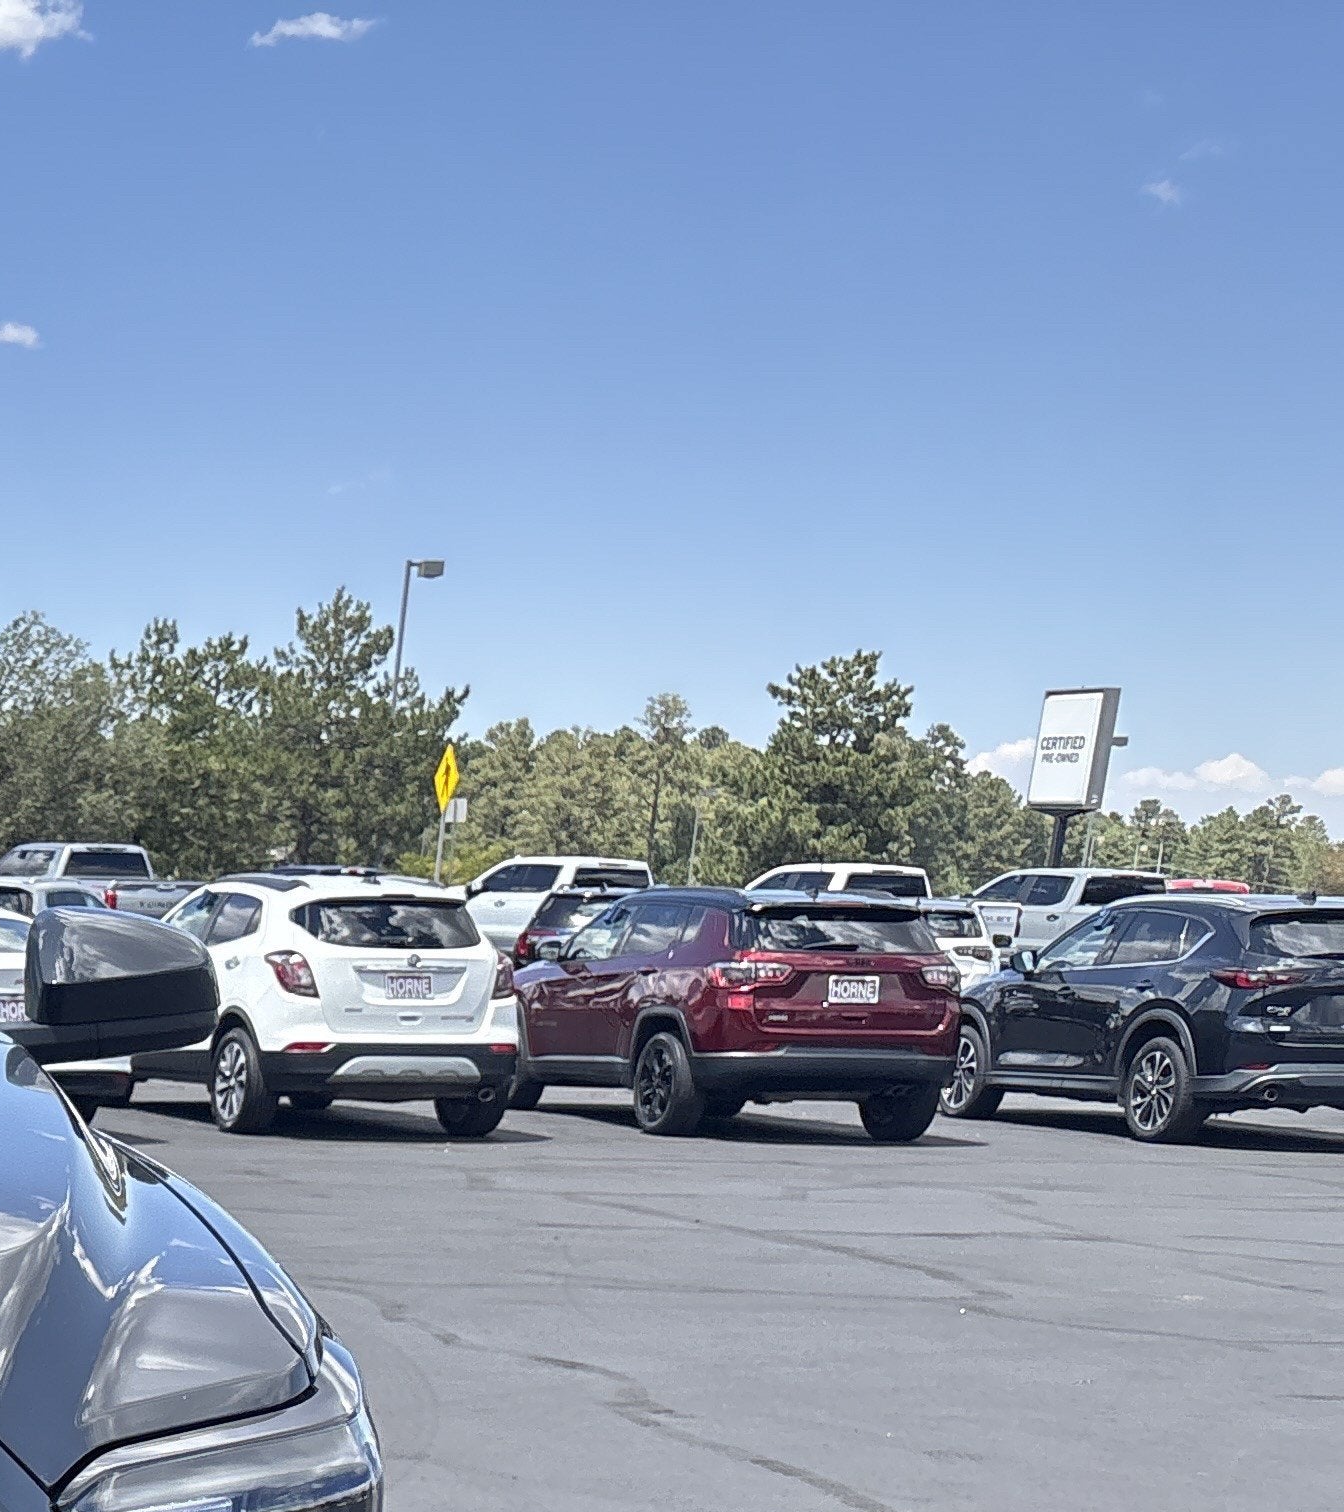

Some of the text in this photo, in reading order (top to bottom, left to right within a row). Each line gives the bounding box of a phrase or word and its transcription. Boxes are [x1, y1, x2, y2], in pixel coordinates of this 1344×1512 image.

[1040, 735, 1086, 751] CERTIFIED
[387, 977, 430, 995] HORNE
[831, 980, 876, 998] HORNE
[0, 1001, 27, 1021] HOR
